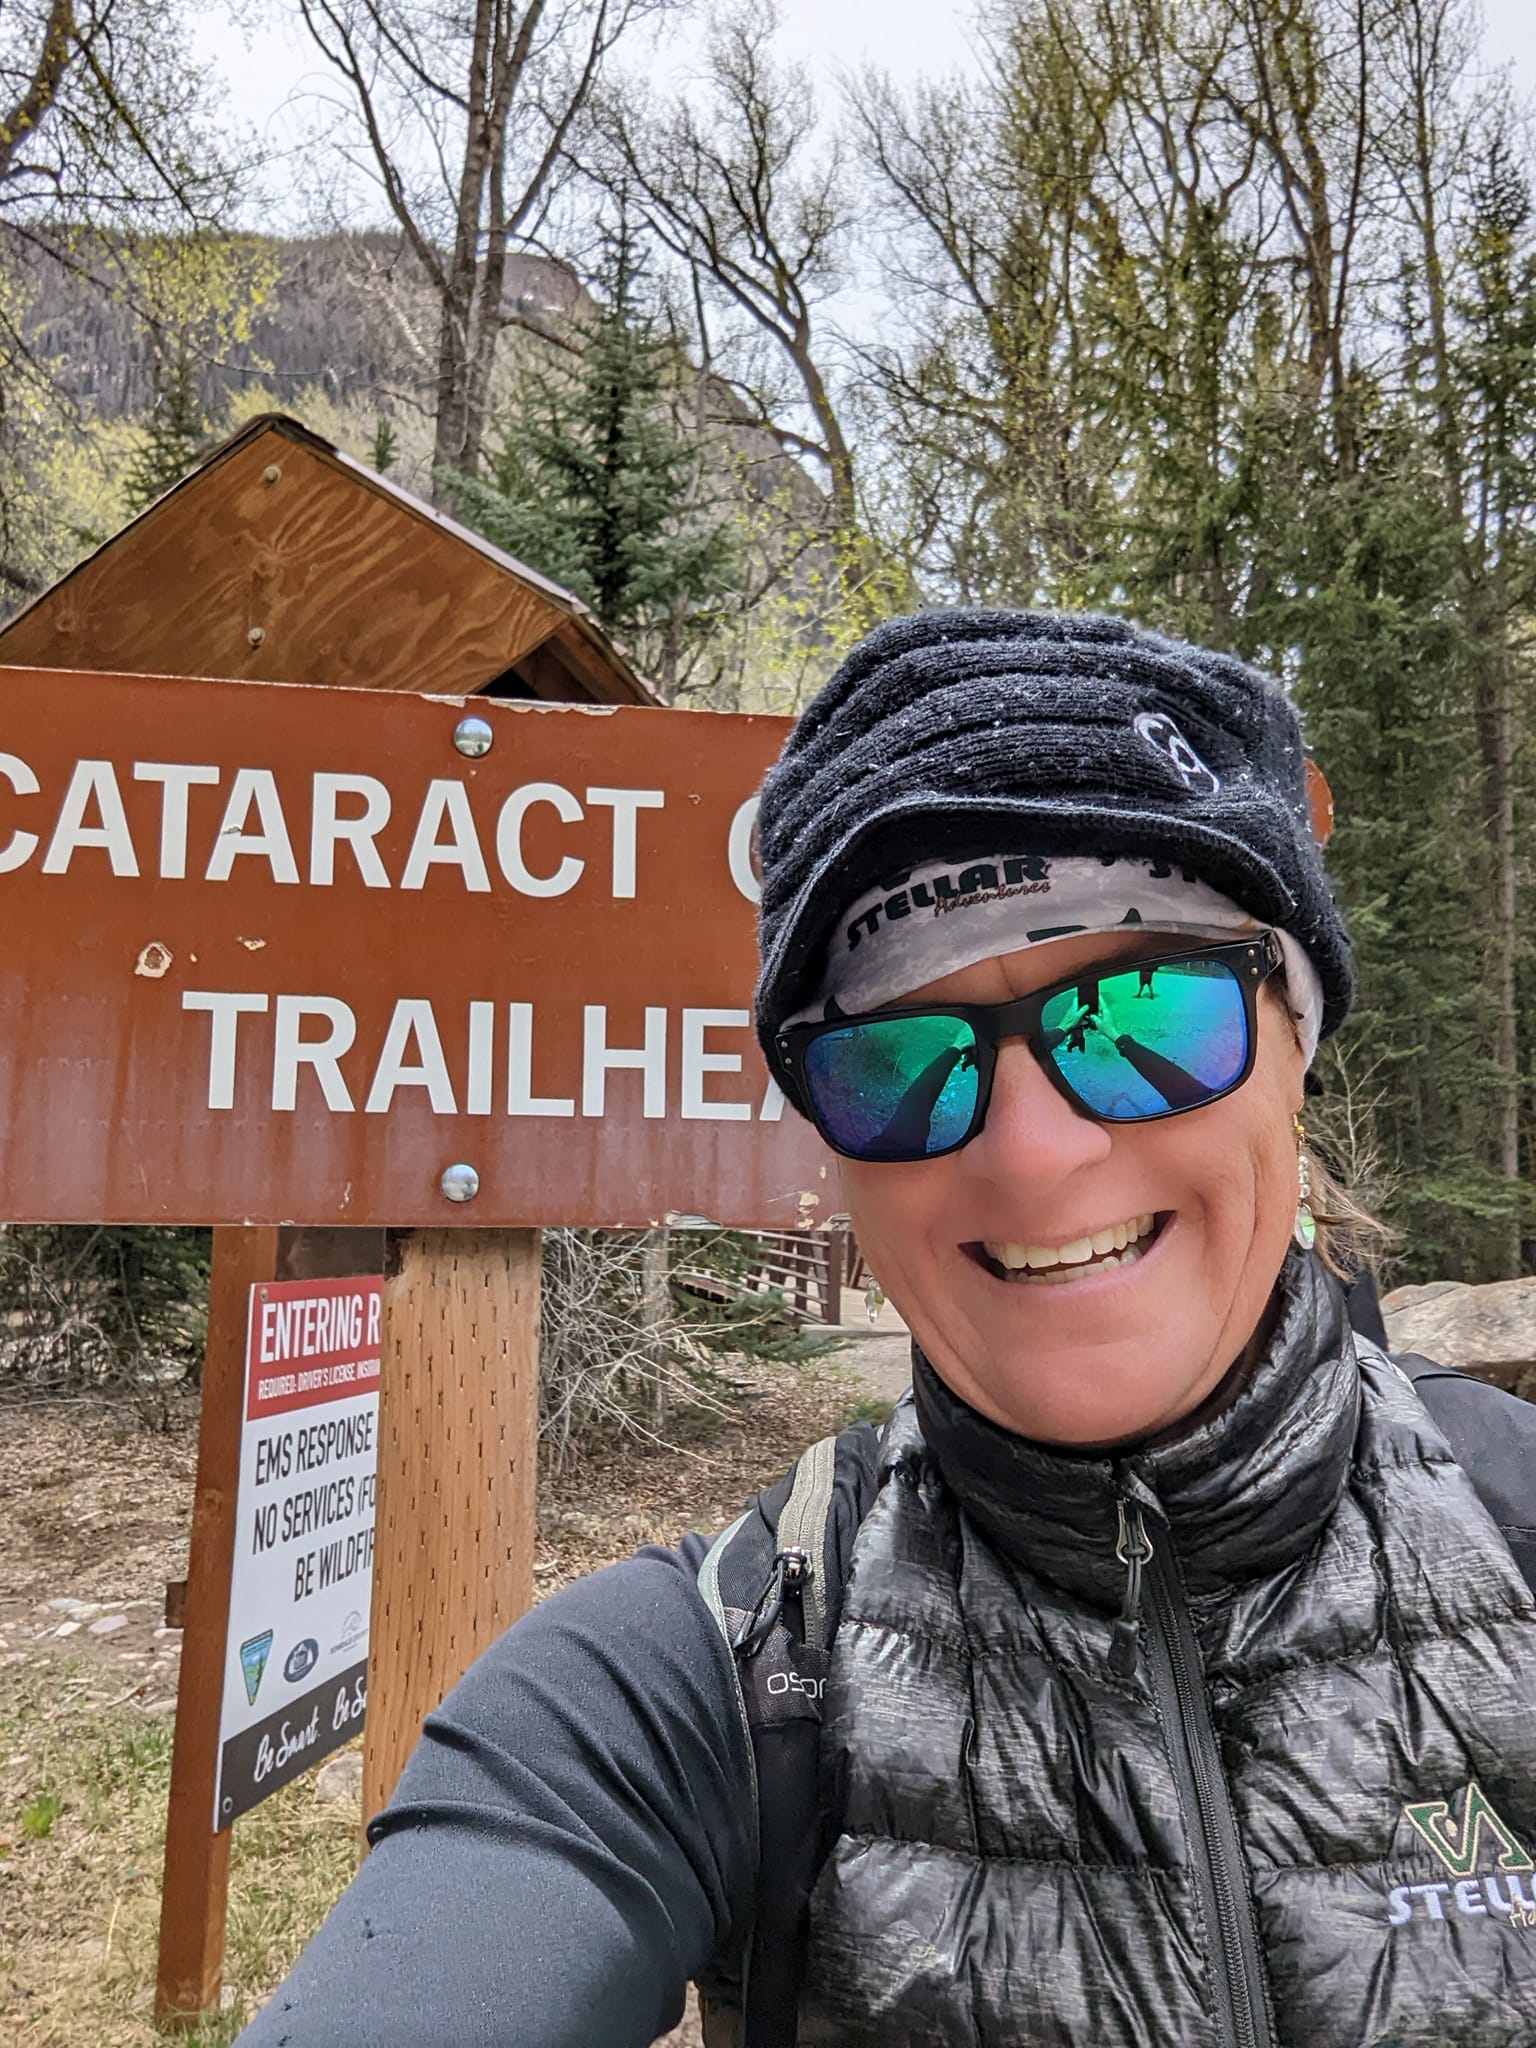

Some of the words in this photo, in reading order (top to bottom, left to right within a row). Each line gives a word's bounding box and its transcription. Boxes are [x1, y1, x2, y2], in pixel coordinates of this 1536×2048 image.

[847, 857, 1051, 951] STELLAR
[260, 1295, 363, 1363] ENTERING
[357, 1358, 380, 1379] INS
[255, 1433, 292, 1487] EMS
[296, 1411, 374, 1474] RESPONSE
[253, 1502, 278, 1555] NO
[282, 1475, 354, 1543] SERVICES
[294, 1551, 316, 1603] BE
[254, 1733, 275, 1784] Be
[332, 1686, 350, 1731] Be
[1388, 1874, 1536, 1925] STELL
